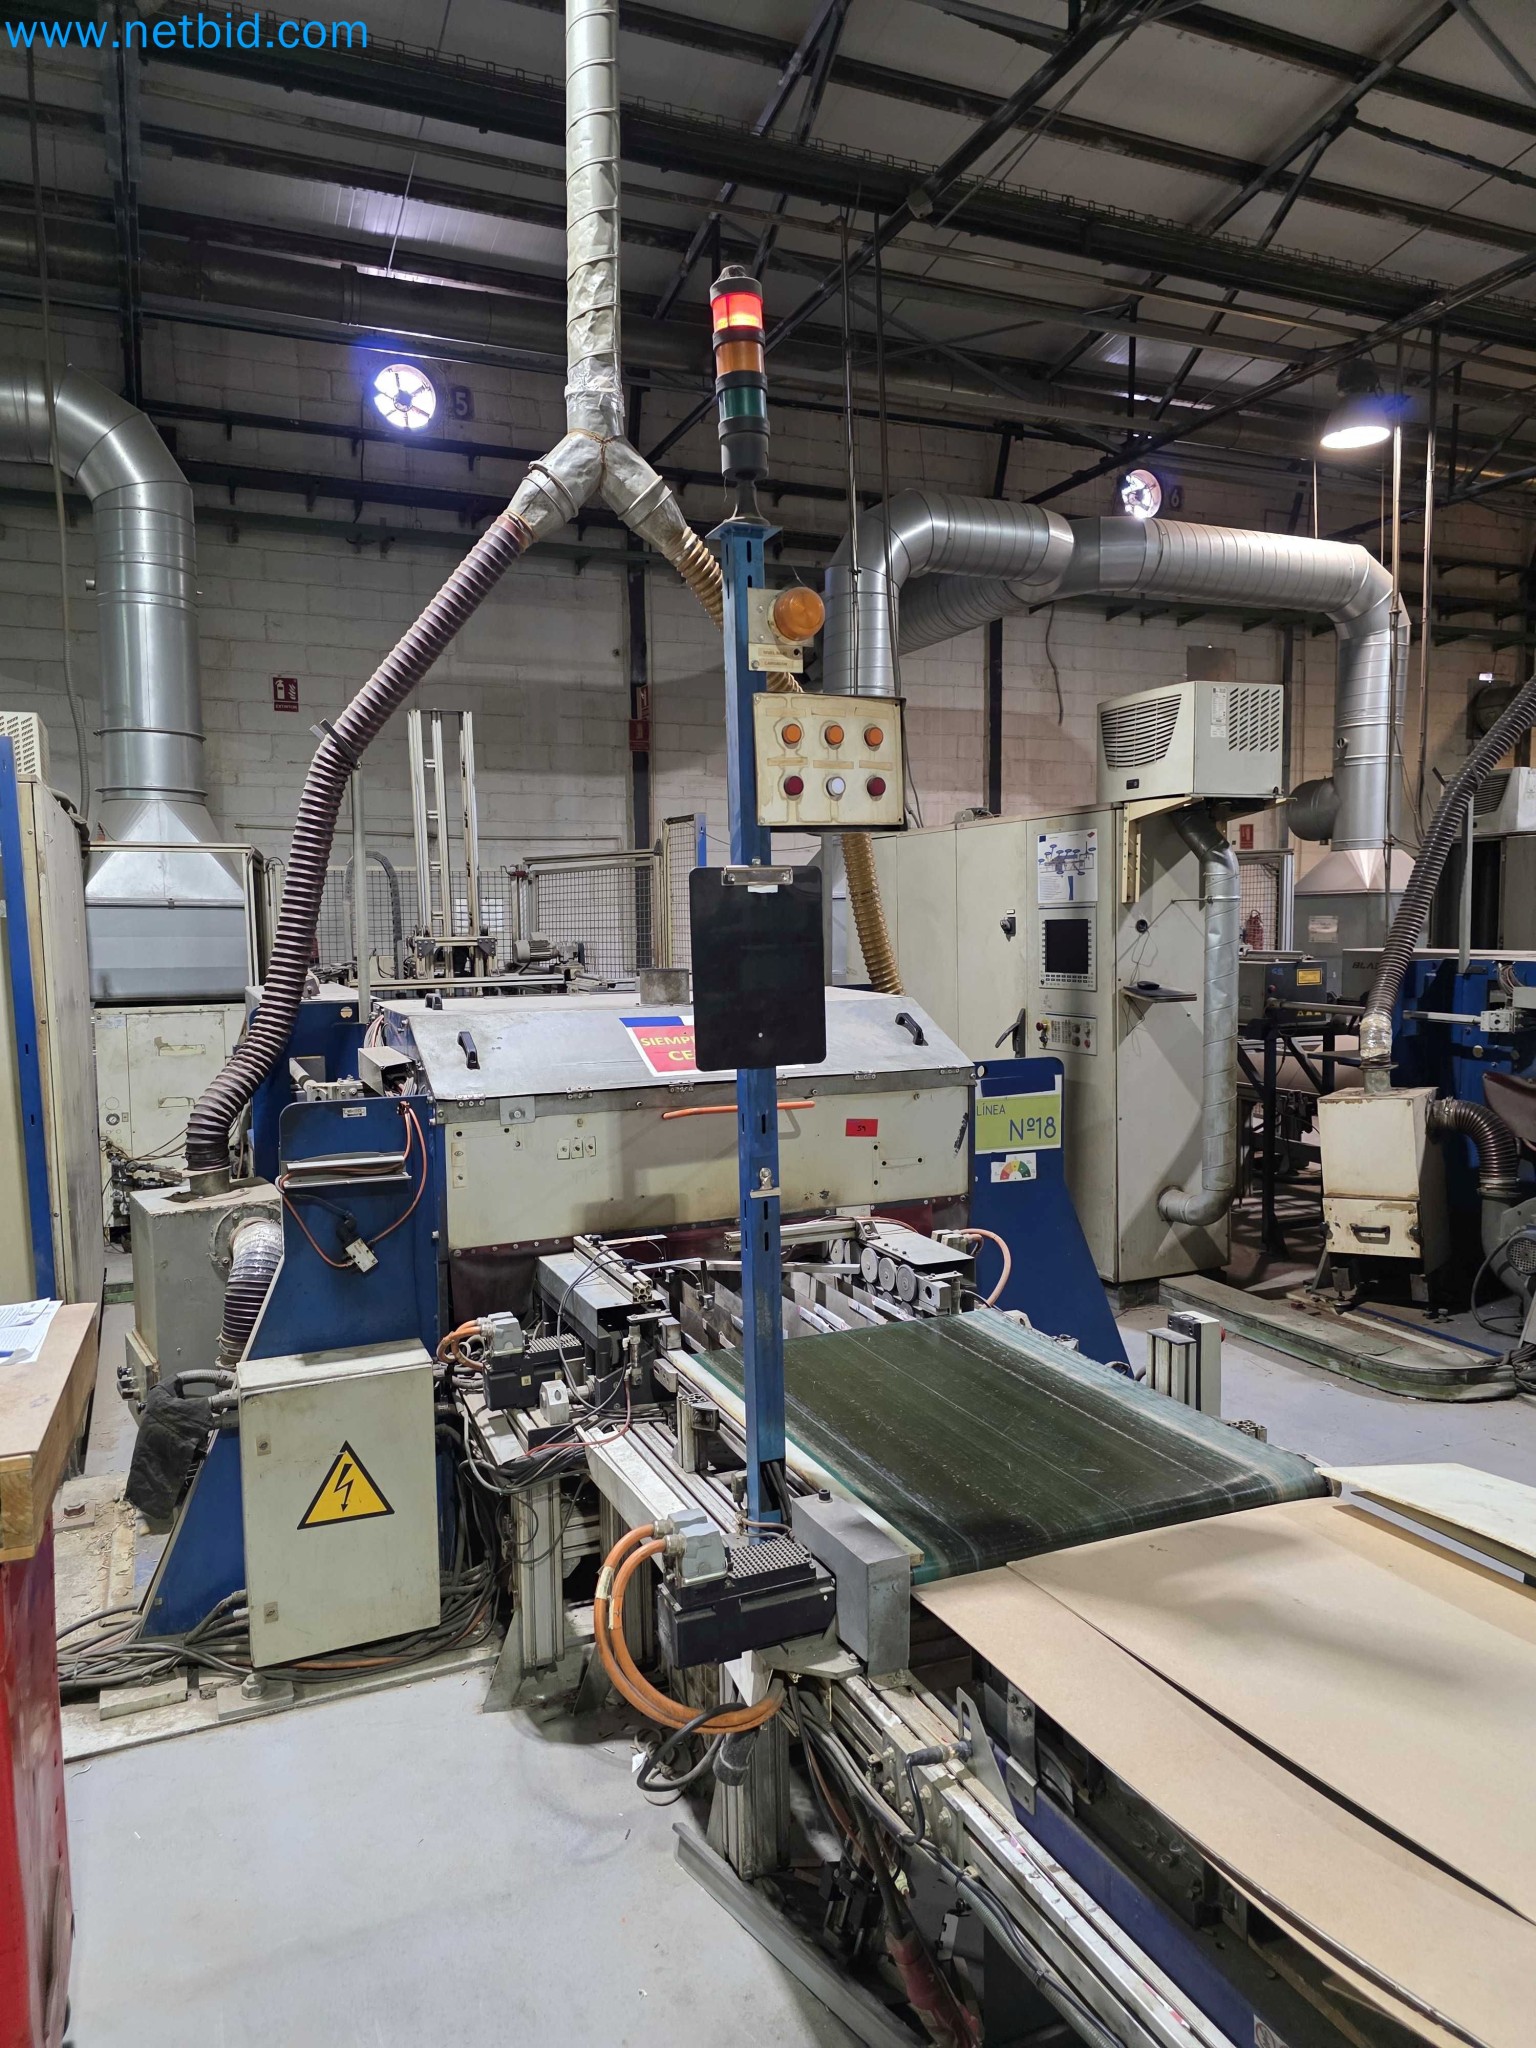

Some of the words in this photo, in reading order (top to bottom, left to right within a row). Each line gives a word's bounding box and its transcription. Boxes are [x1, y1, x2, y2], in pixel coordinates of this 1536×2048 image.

[455, 391, 468, 416] 5
[640, 1035, 695, 1047] SIEMP
[976, 1103, 1006, 1117] LÍNEA
